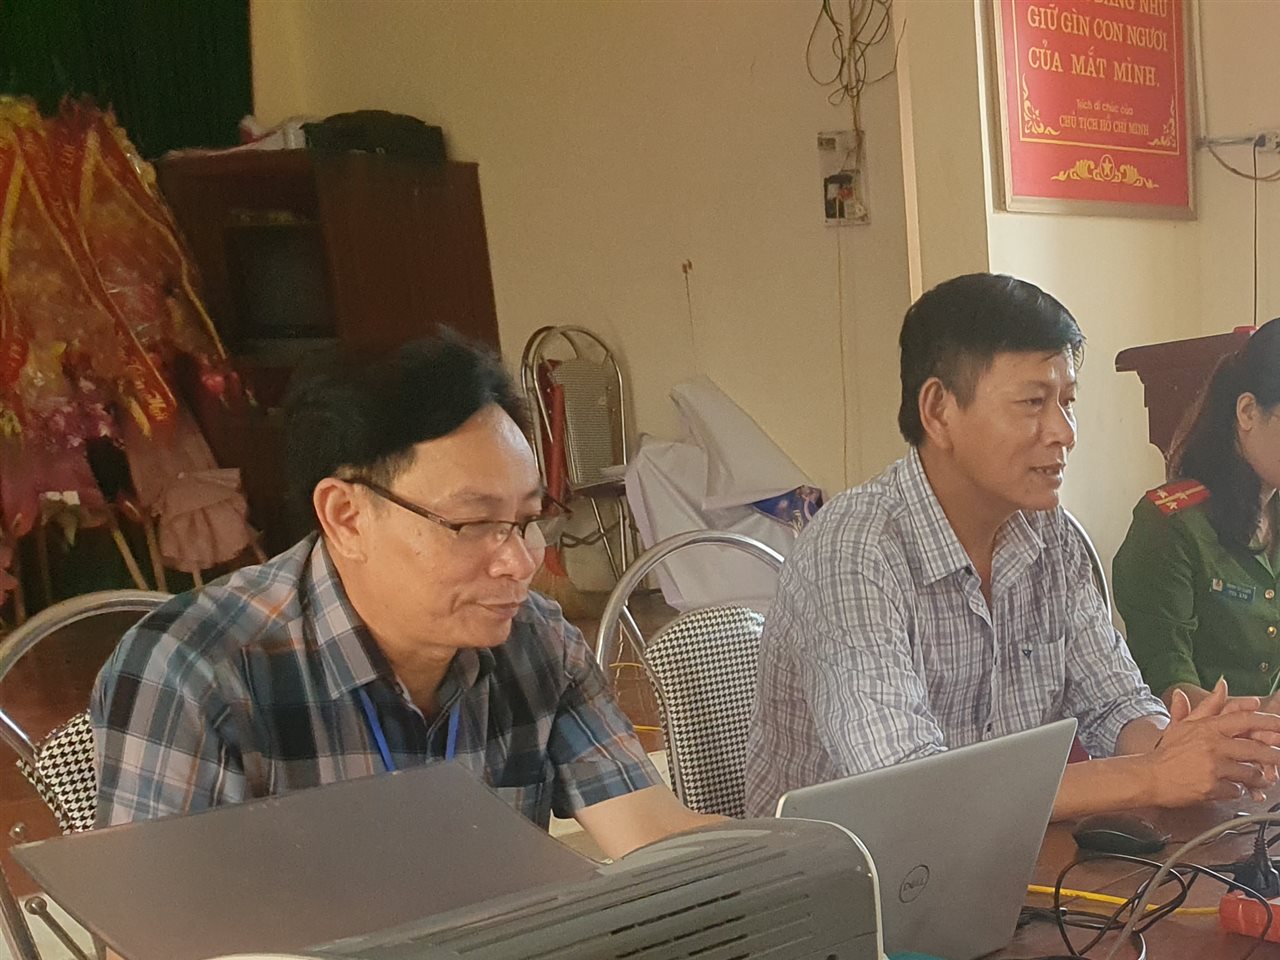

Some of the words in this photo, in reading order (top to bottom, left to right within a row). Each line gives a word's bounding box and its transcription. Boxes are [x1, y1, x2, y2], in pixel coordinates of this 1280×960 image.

[1028, 4, 1058, 30] GIỮ
[1061, 8, 1089, 37] GÌN
[1094, 18, 1123, 43] CON
[1028, 39, 1063, 72] CỦA
[1071, 46, 1107, 78] MẮT
[1060, 111, 1076, 128] CHỦ
